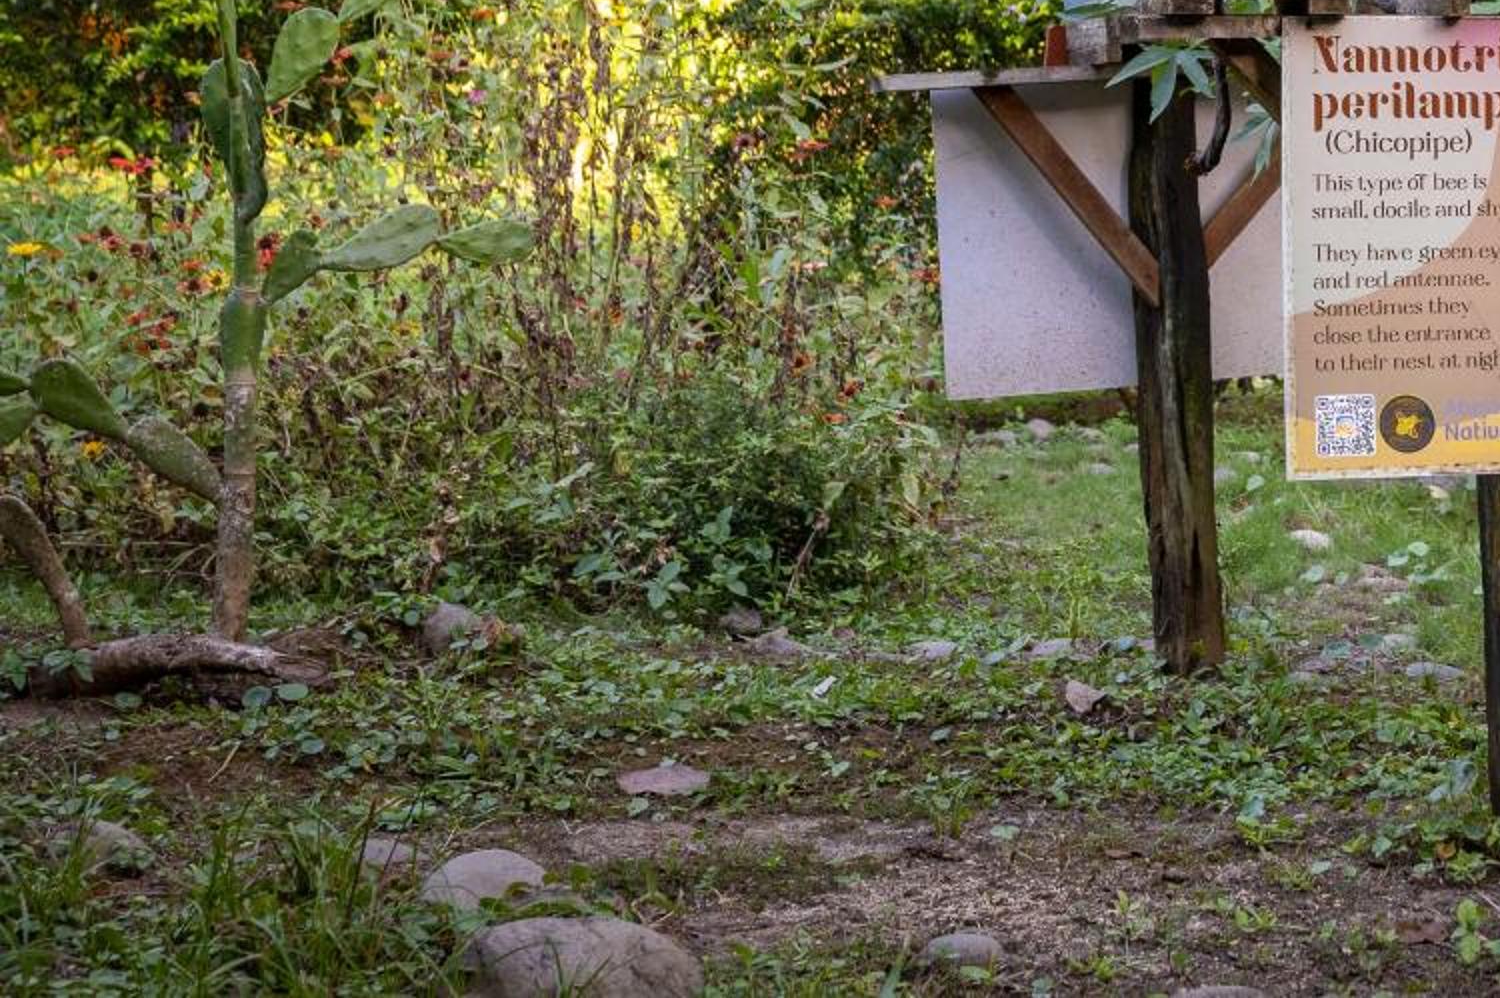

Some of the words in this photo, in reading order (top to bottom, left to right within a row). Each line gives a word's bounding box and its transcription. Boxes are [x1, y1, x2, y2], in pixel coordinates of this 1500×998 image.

[1325, 128, 1473, 160] (Chicopipe)
[1312, 173, 1353, 192] This
[1358, 174, 1403, 197] type
[1407, 173, 1428, 191] of
[1433, 173, 1468, 191] bee
[1472, 173, 1488, 191] is
[1312, 201, 1369, 219] small,
[1373, 200, 1431, 218] docile
[1434, 200, 1472, 218] and
[1312, 243, 1360, 267] They
[1366, 242, 1413, 262] have
[1418, 242, 1474, 264] green
[1313, 271, 1350, 290] and
[1355, 270, 1388, 289] red
[1393, 270, 1490, 289] antennae.
[1313, 299, 1424, 318] Sometimes
[1428, 298, 1473, 318] they
[1313, 326, 1363, 345] close
[1367, 325, 1400, 344] the
[1404, 325, 1492, 342] entrance
[1314, 355, 1336, 372] to
[1340, 353, 1386, 372] their
[1392, 352, 1435, 370] nest
[1438, 353, 1462, 370] at
